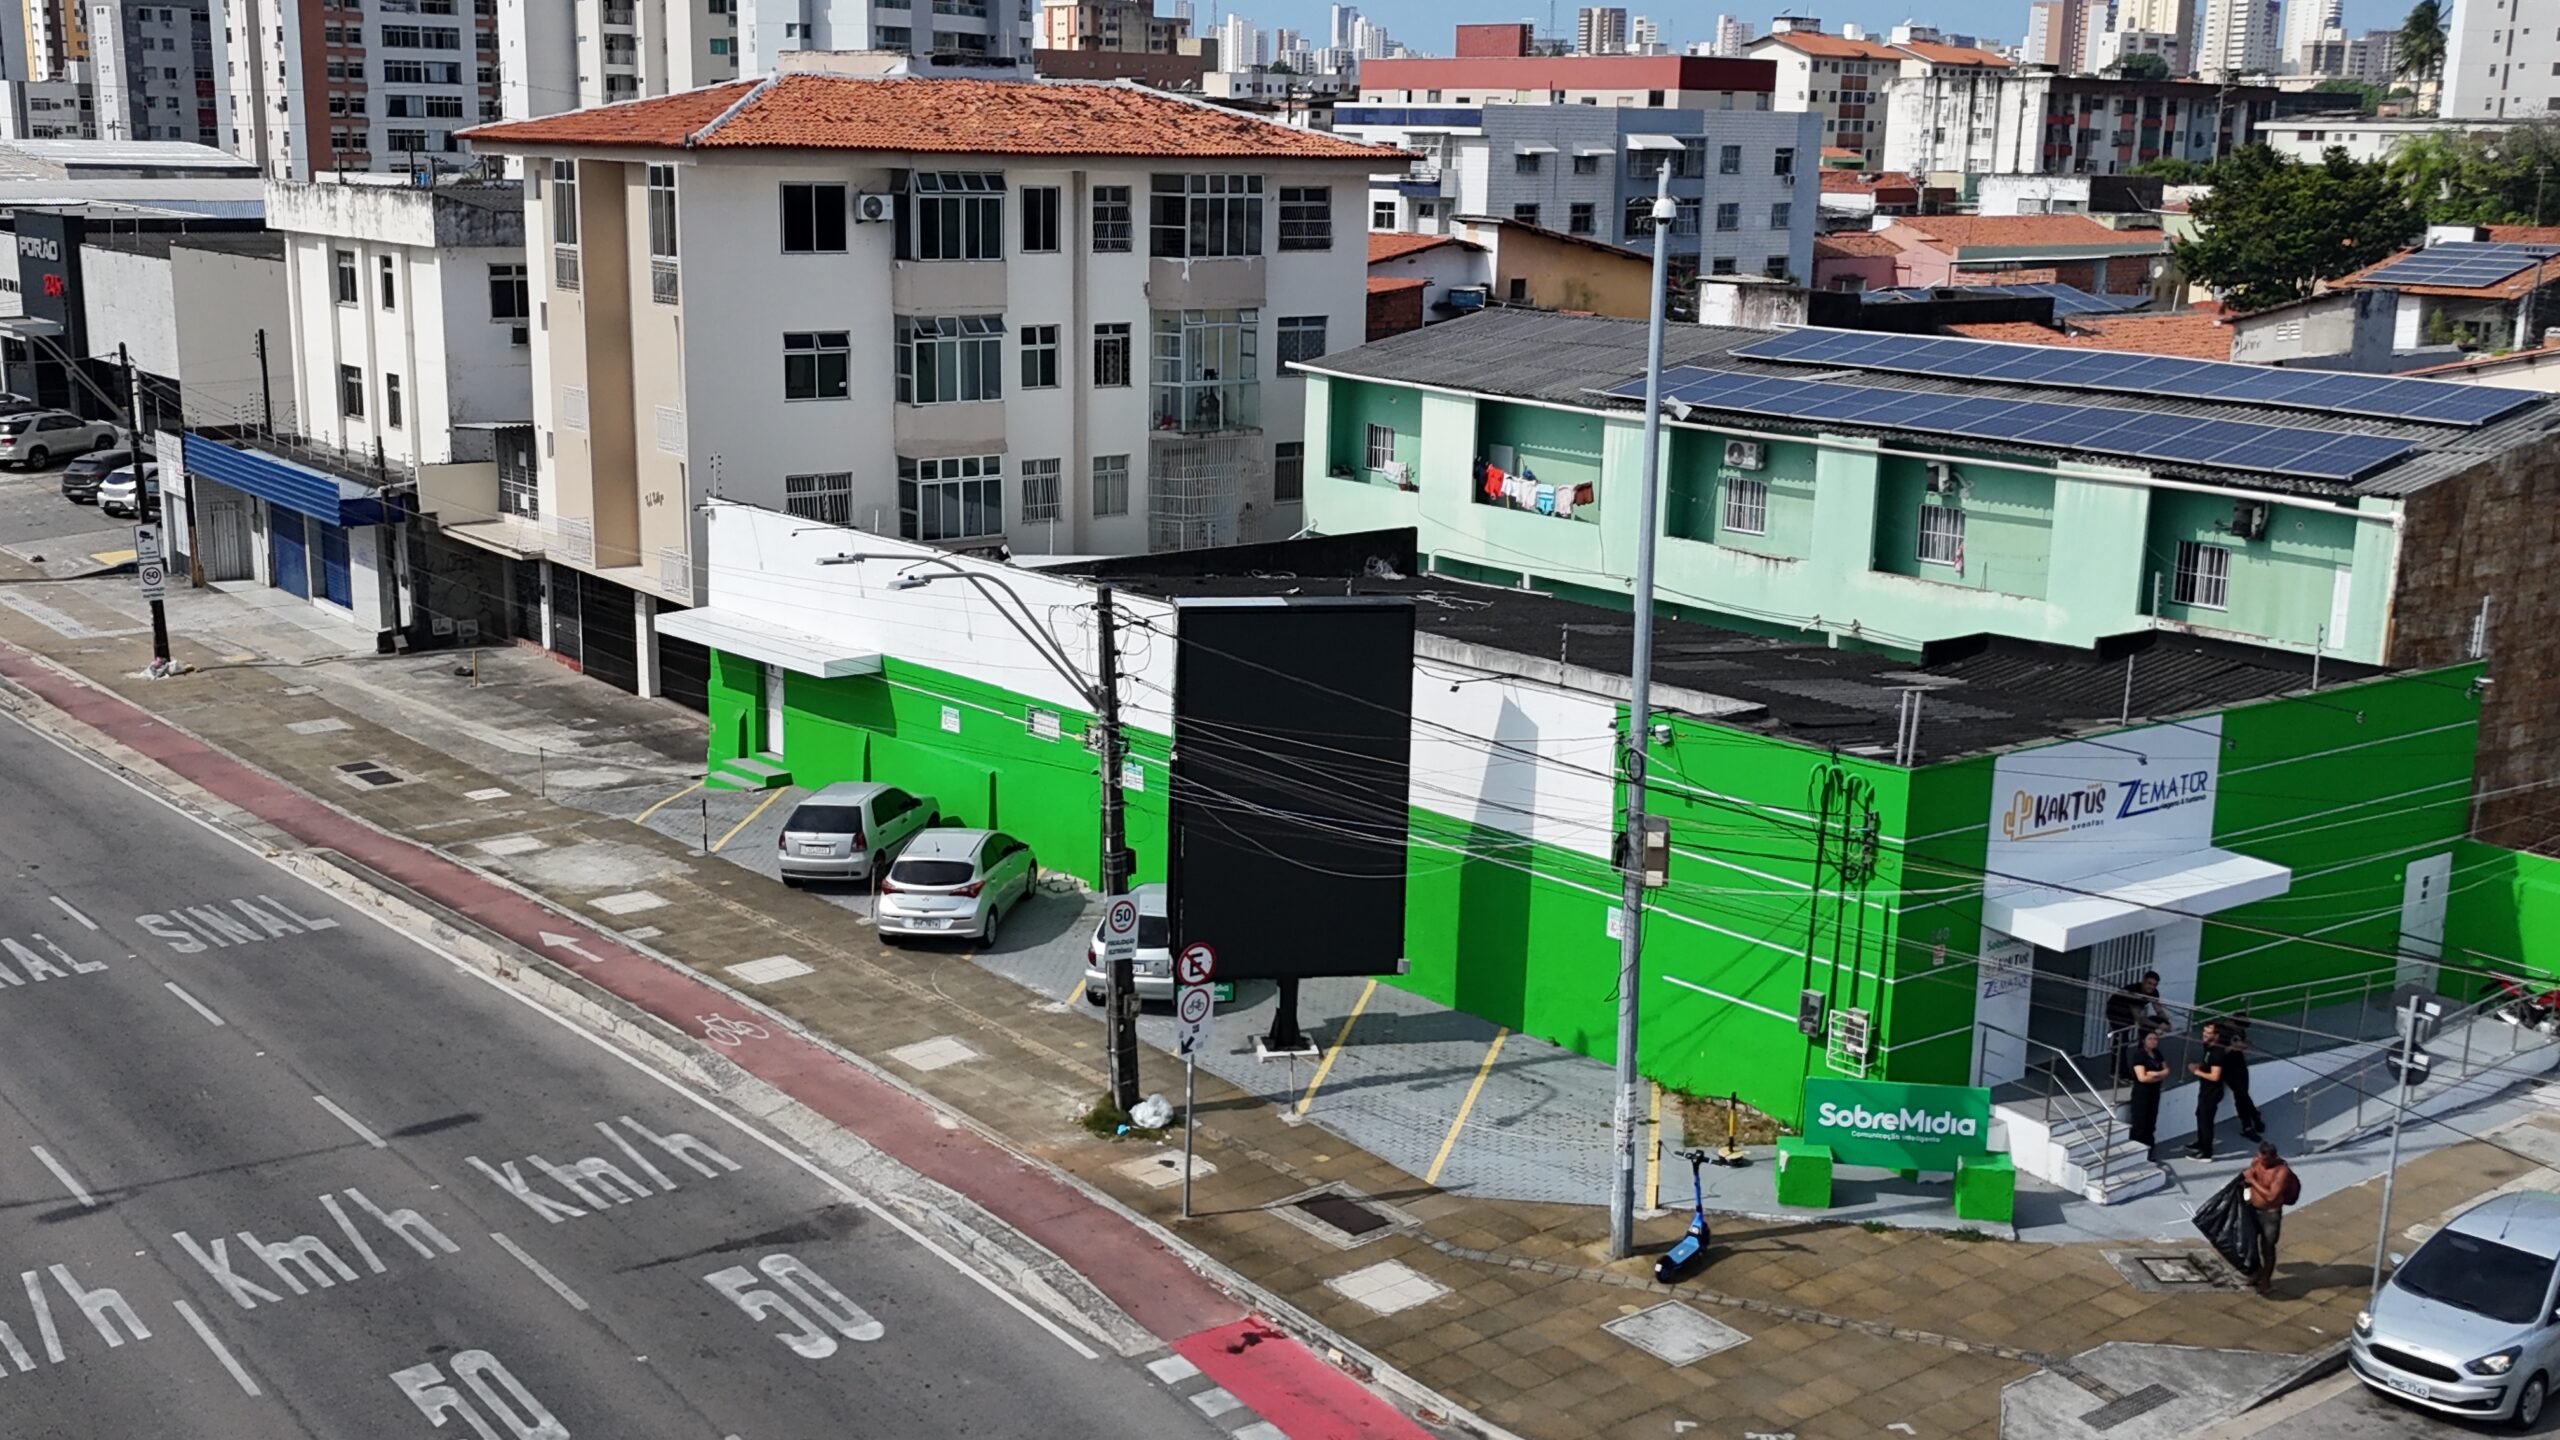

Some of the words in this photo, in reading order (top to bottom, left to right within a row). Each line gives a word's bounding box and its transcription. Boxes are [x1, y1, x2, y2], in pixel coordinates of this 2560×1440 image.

[146, 571, 158, 579] 50
[2035, 787, 2106, 828] KAKTUS
[2116, 771, 2208, 819] ZEMATUR
[136, 895, 340, 953] SINAL
[1115, 908, 1132, 922] 50
[465, 1116, 741, 1223] Km/h
[172, 1188, 461, 1309] Km/h
[703, 1254, 885, 1359] 50
[388, 1350, 571, 1440] 50
